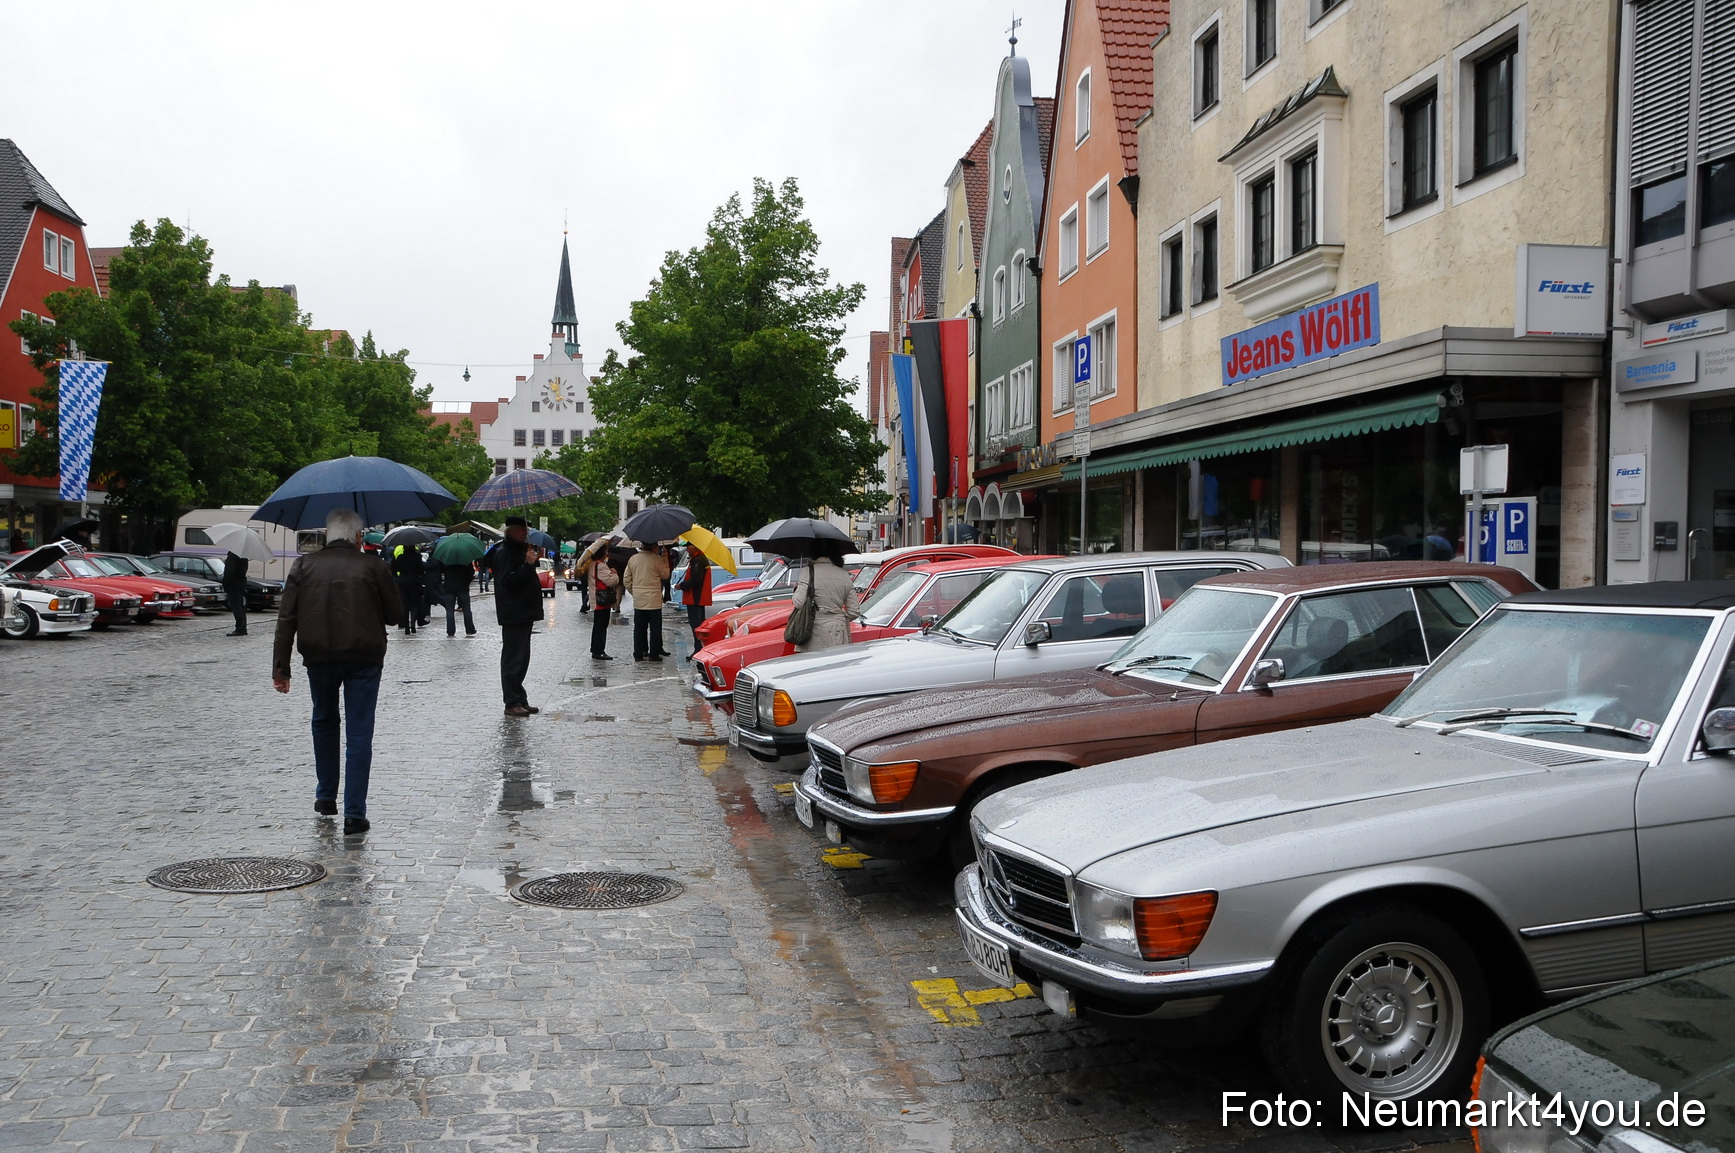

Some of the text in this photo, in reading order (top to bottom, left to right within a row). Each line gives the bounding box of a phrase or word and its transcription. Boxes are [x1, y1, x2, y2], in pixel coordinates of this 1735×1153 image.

[1538, 280, 1595, 294] Fürst
[1226, 291, 1372, 379] Jeans Wölfl
[1667, 319, 1699, 333] Fürst
[1078, 342, 1088, 378] P
[1625, 359, 1677, 379] Barmenia
[1616, 467, 1641, 476] Fürst
[1340, 474, 1359, 544] DOCK'S
[1510, 509, 1525, 533] P
